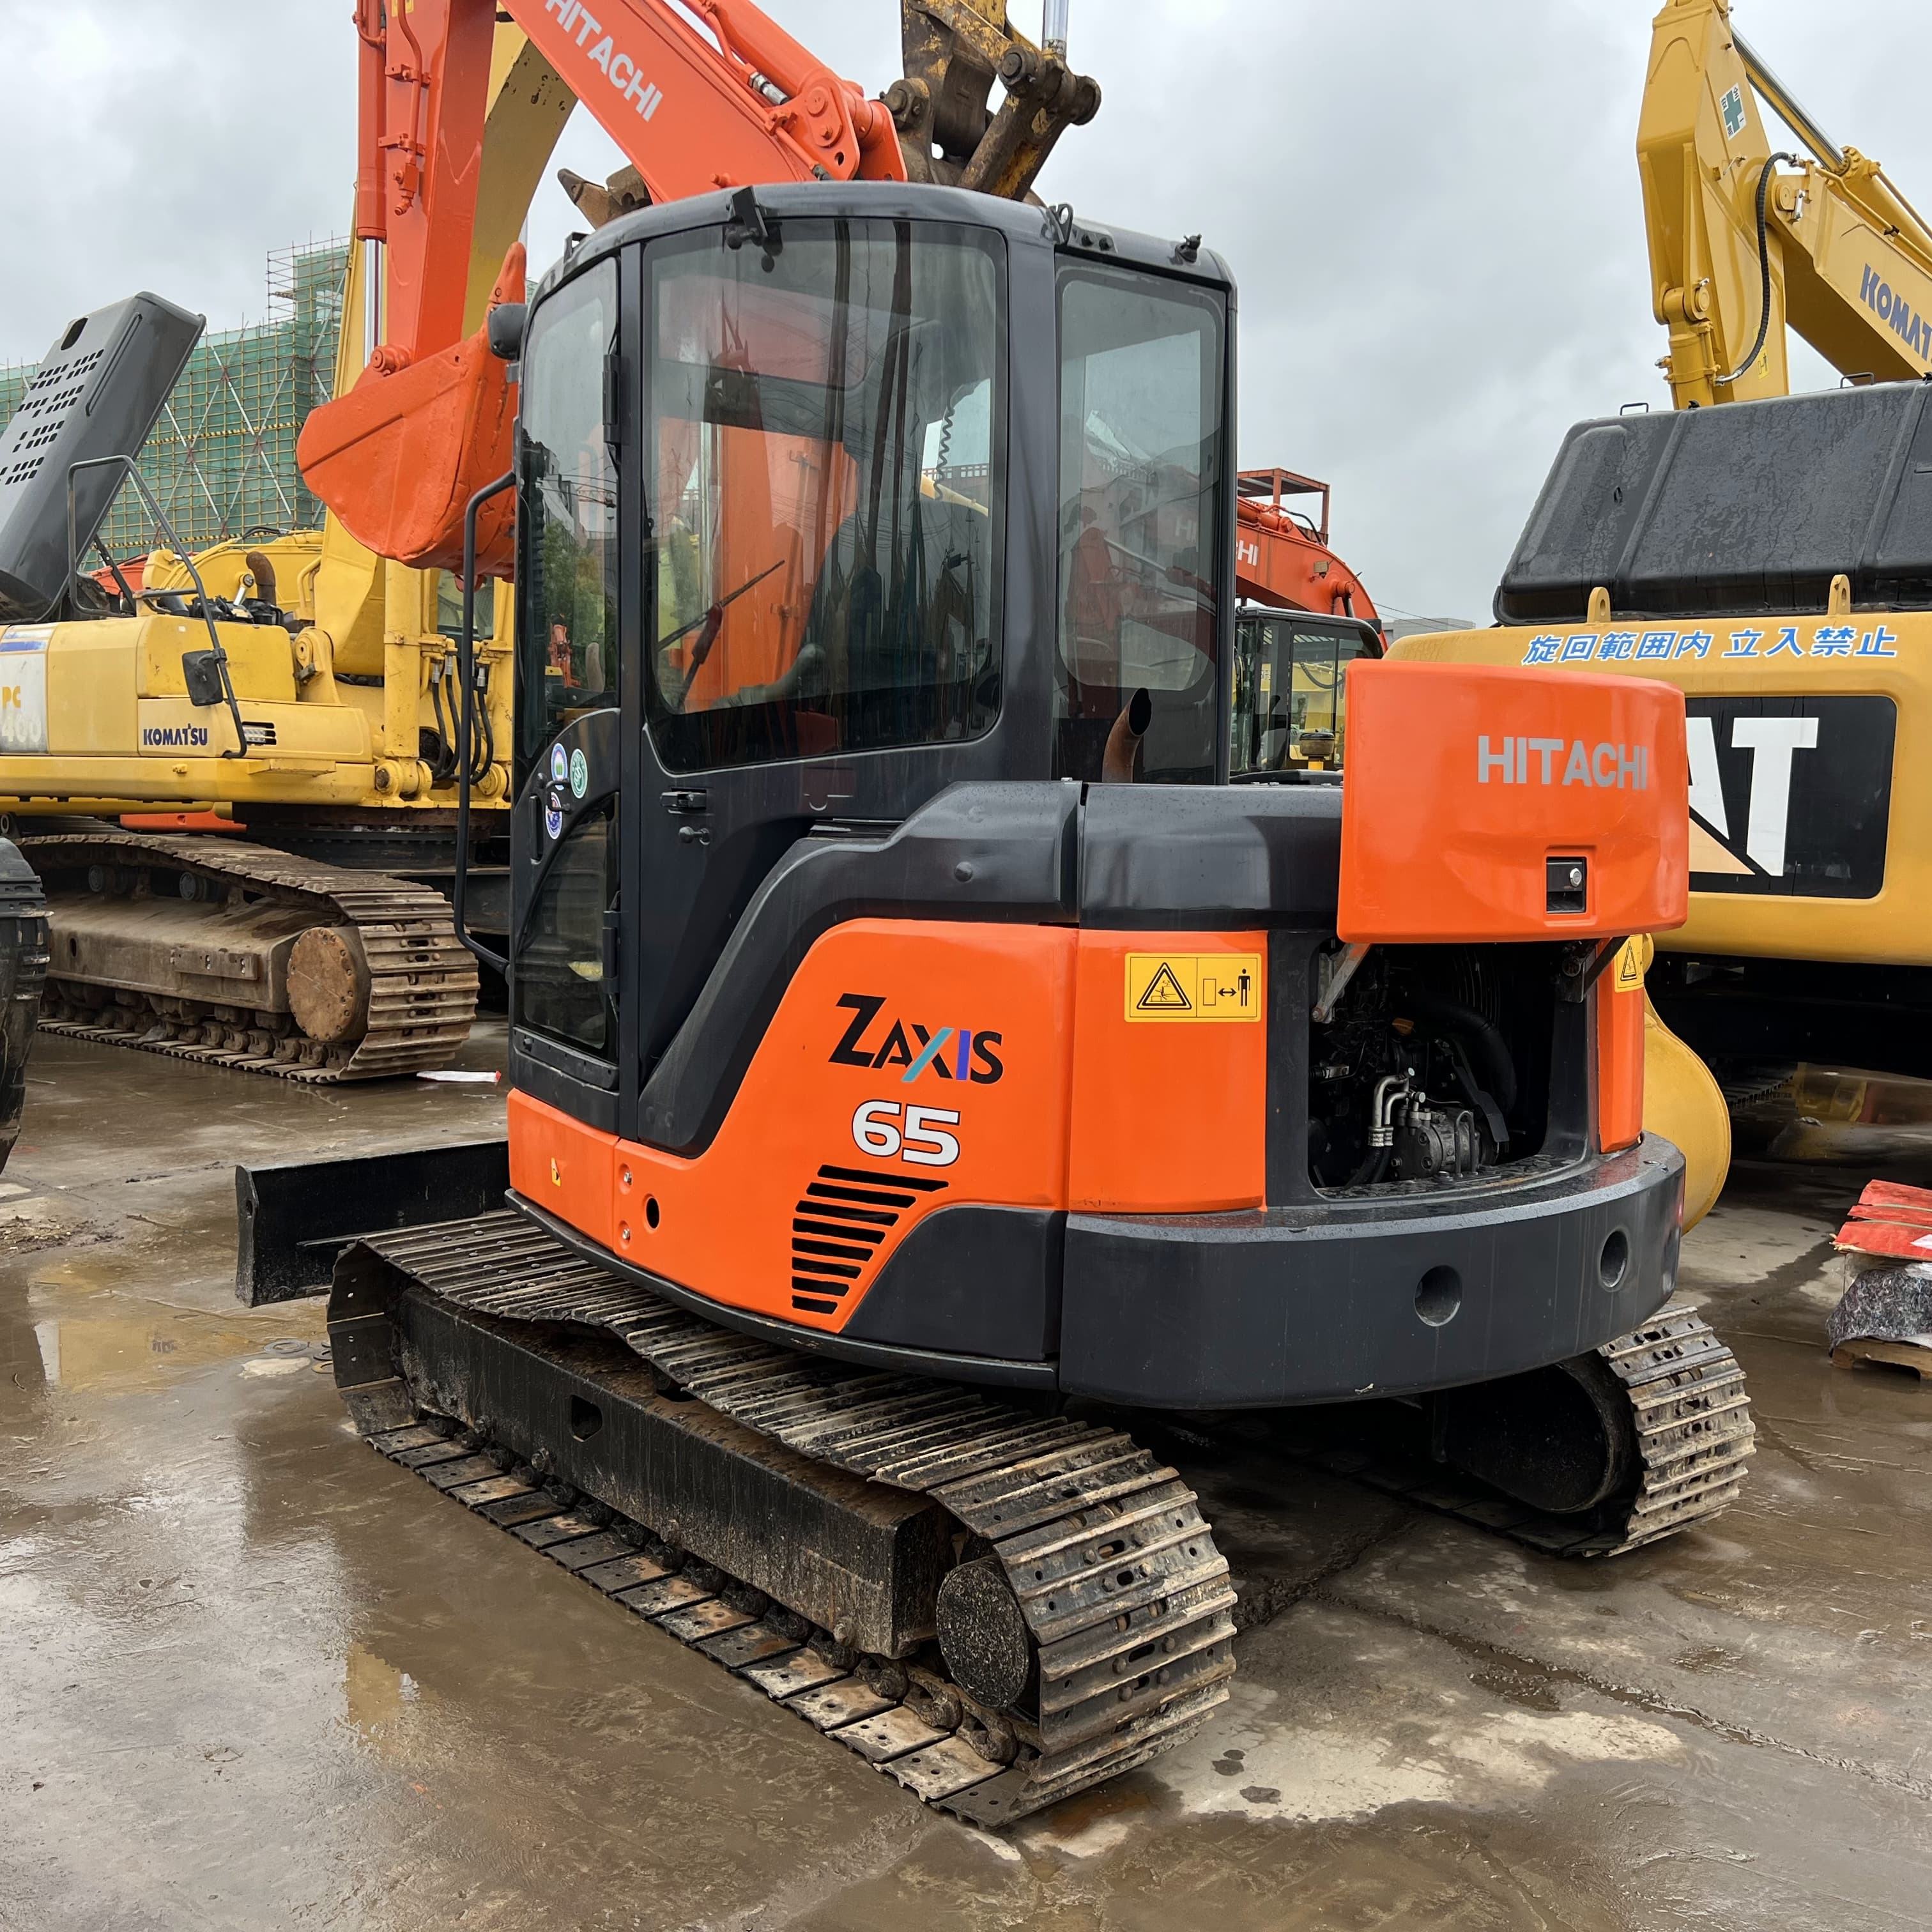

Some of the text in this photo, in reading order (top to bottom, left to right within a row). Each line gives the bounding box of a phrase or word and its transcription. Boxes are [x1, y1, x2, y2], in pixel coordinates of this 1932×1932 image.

[1860, 263, 1932, 364] KOMAT
[1521, 625, 1899, 665] 旋回範囲内 立入禁止
[2, 686, 21, 709] PC
[143, 723, 208, 746] KOMATSU
[1478, 735, 1648, 790] HITACHI
[828, 992, 1004, 1084] ZAXIS
[852, 1099, 961, 1167] 65
